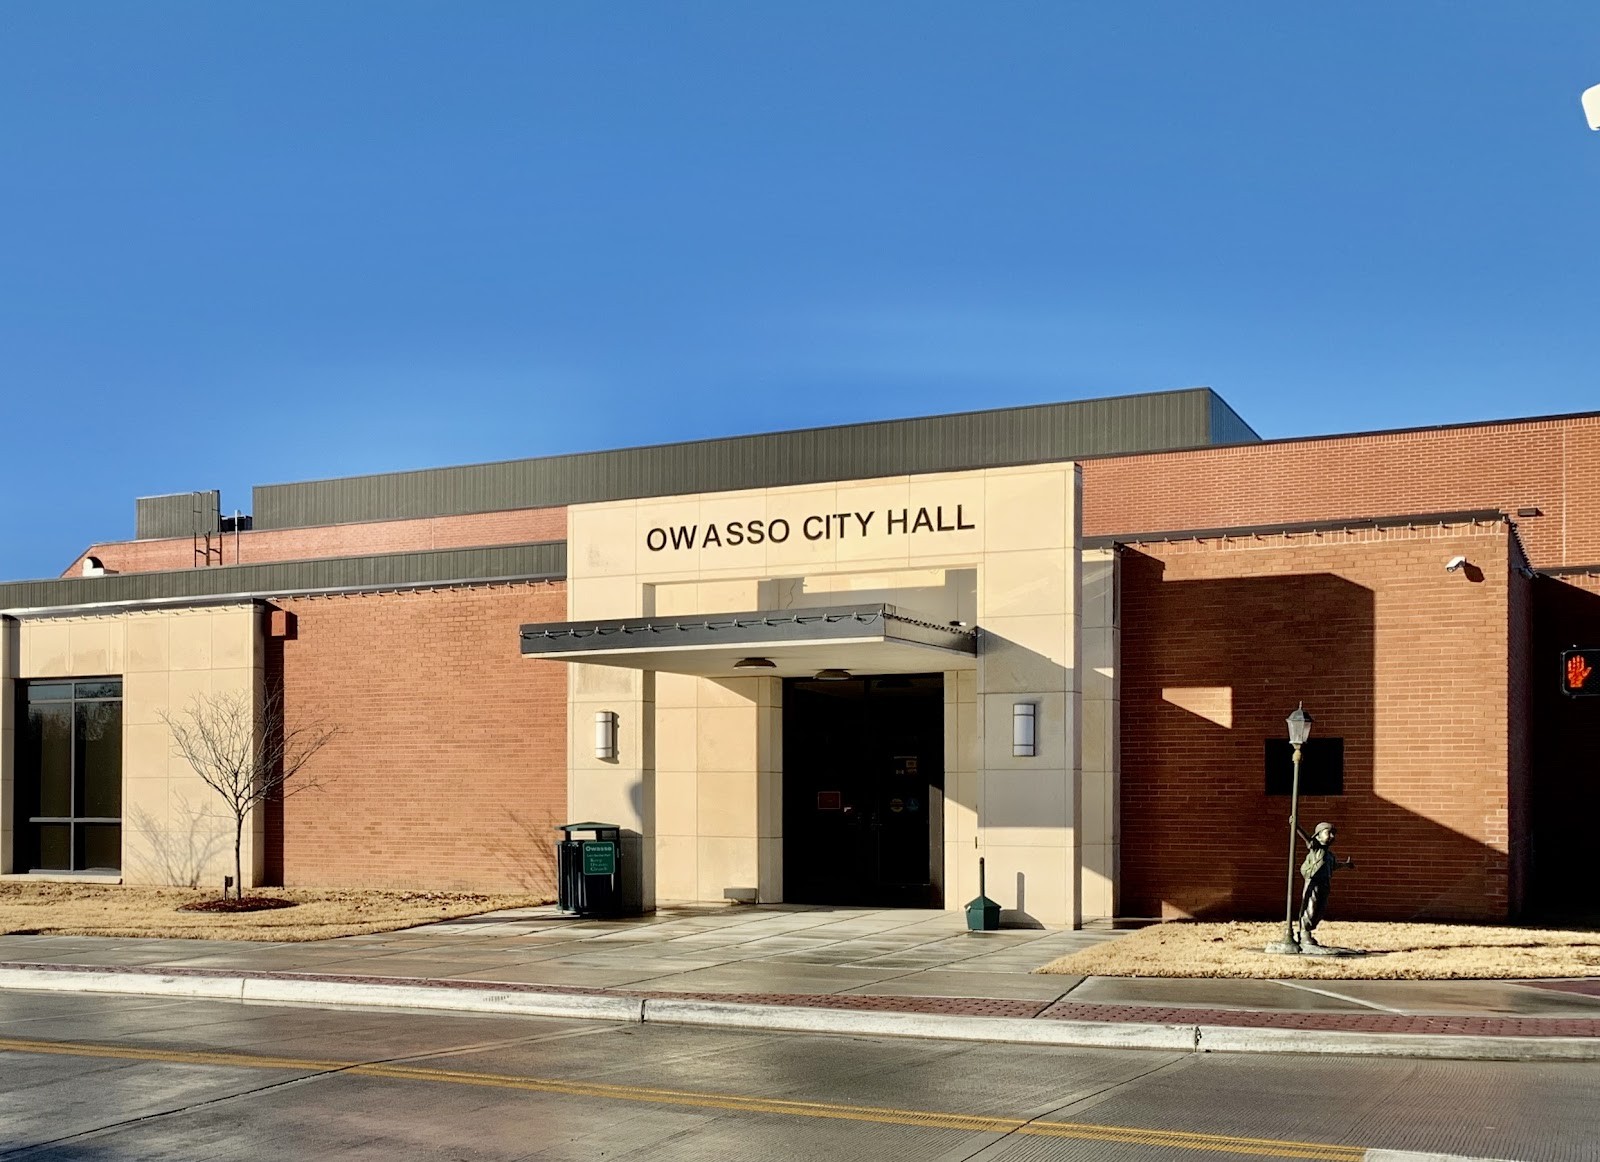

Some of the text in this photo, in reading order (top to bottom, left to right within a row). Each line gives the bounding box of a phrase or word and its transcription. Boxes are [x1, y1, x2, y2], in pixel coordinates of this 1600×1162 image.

[646, 504, 975, 552] OWASSO CITY HALL
